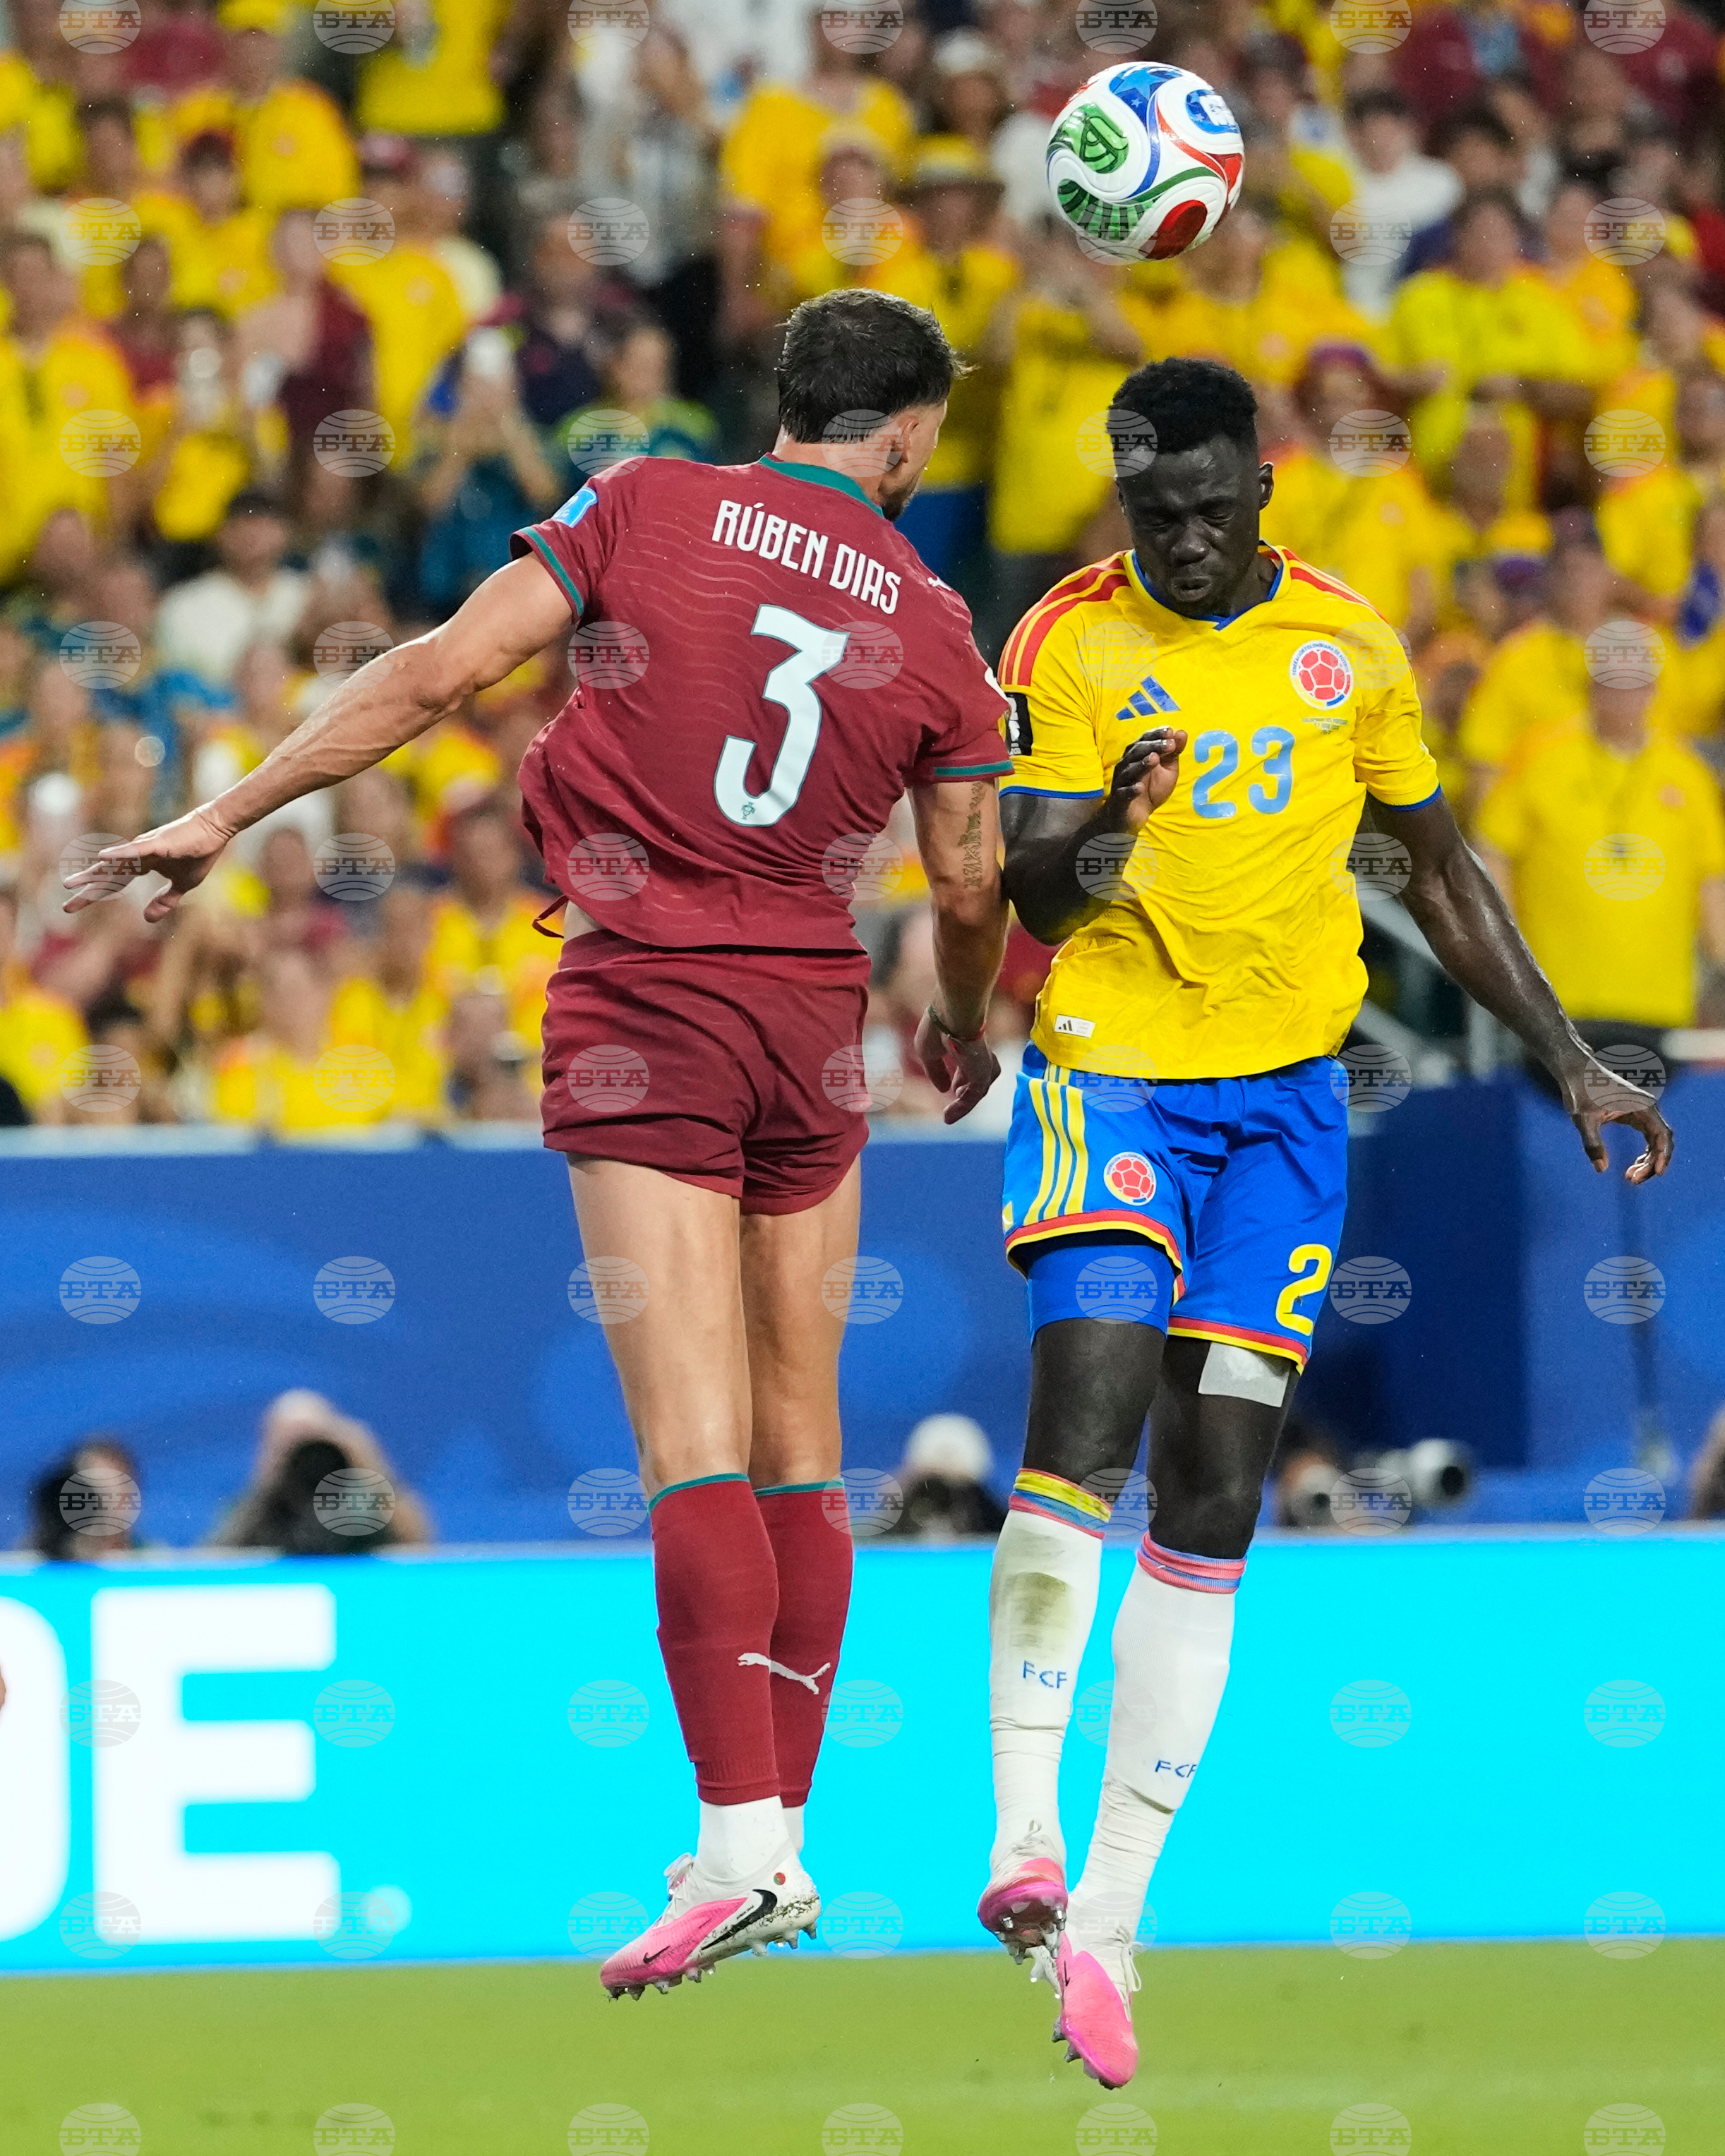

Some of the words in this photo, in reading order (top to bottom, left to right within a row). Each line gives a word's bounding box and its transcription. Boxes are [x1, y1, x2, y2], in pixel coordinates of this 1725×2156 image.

[712, 500, 828, 579] RÚBEN
[829, 543, 901, 614] DIAS
[714, 604, 851, 827] 3
[1192, 726, 1295, 819] 23
[1275, 1243, 1332, 1336] 2
[1023, 1660, 1067, 1689] FCF
[0, 1583, 342, 1945] E
[1155, 1759, 1199, 1778] FCF
